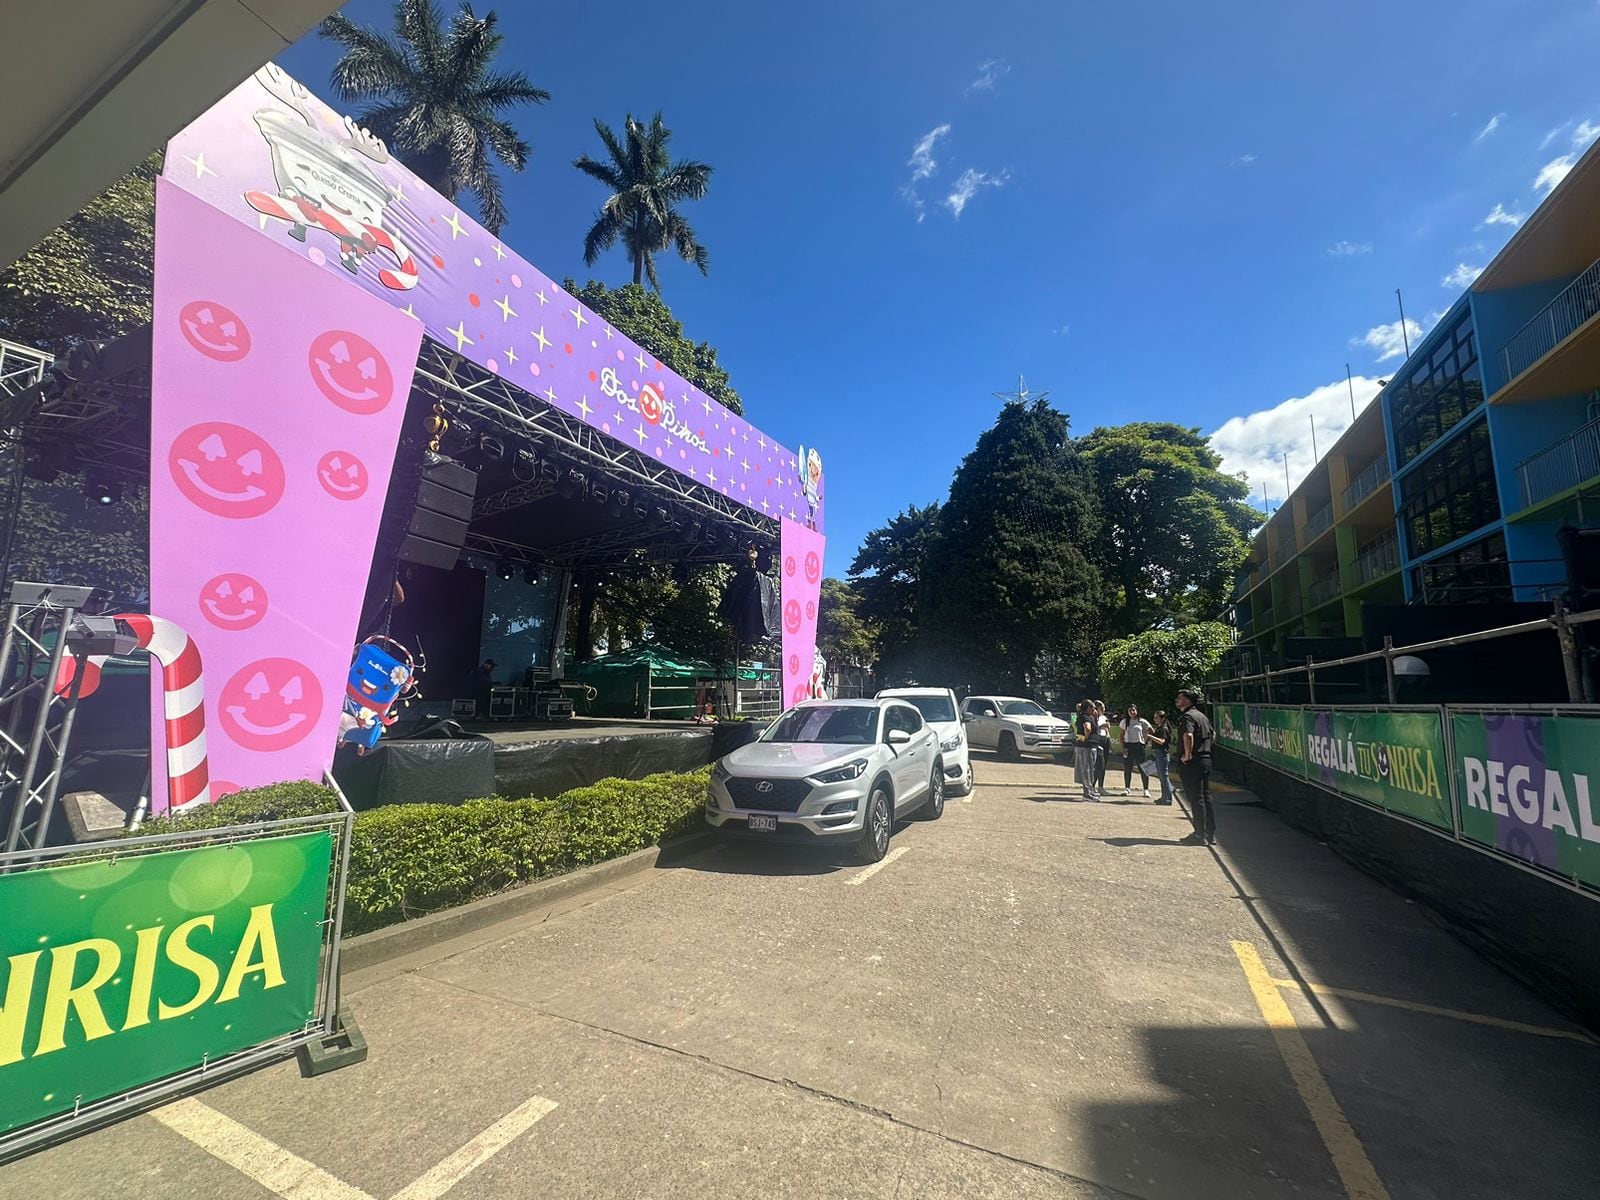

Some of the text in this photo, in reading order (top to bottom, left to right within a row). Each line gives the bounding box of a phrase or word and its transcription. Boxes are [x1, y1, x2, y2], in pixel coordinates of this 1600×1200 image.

[312, 170, 337, 190] Queso
[338, 185, 361, 204] Crema
[600, 367, 711, 454] Dos Pinos
[1307, 732, 1358, 776] REGALÁ
[1357, 746, 1372, 776] TU
[1463, 756, 1600, 844] REGAL
